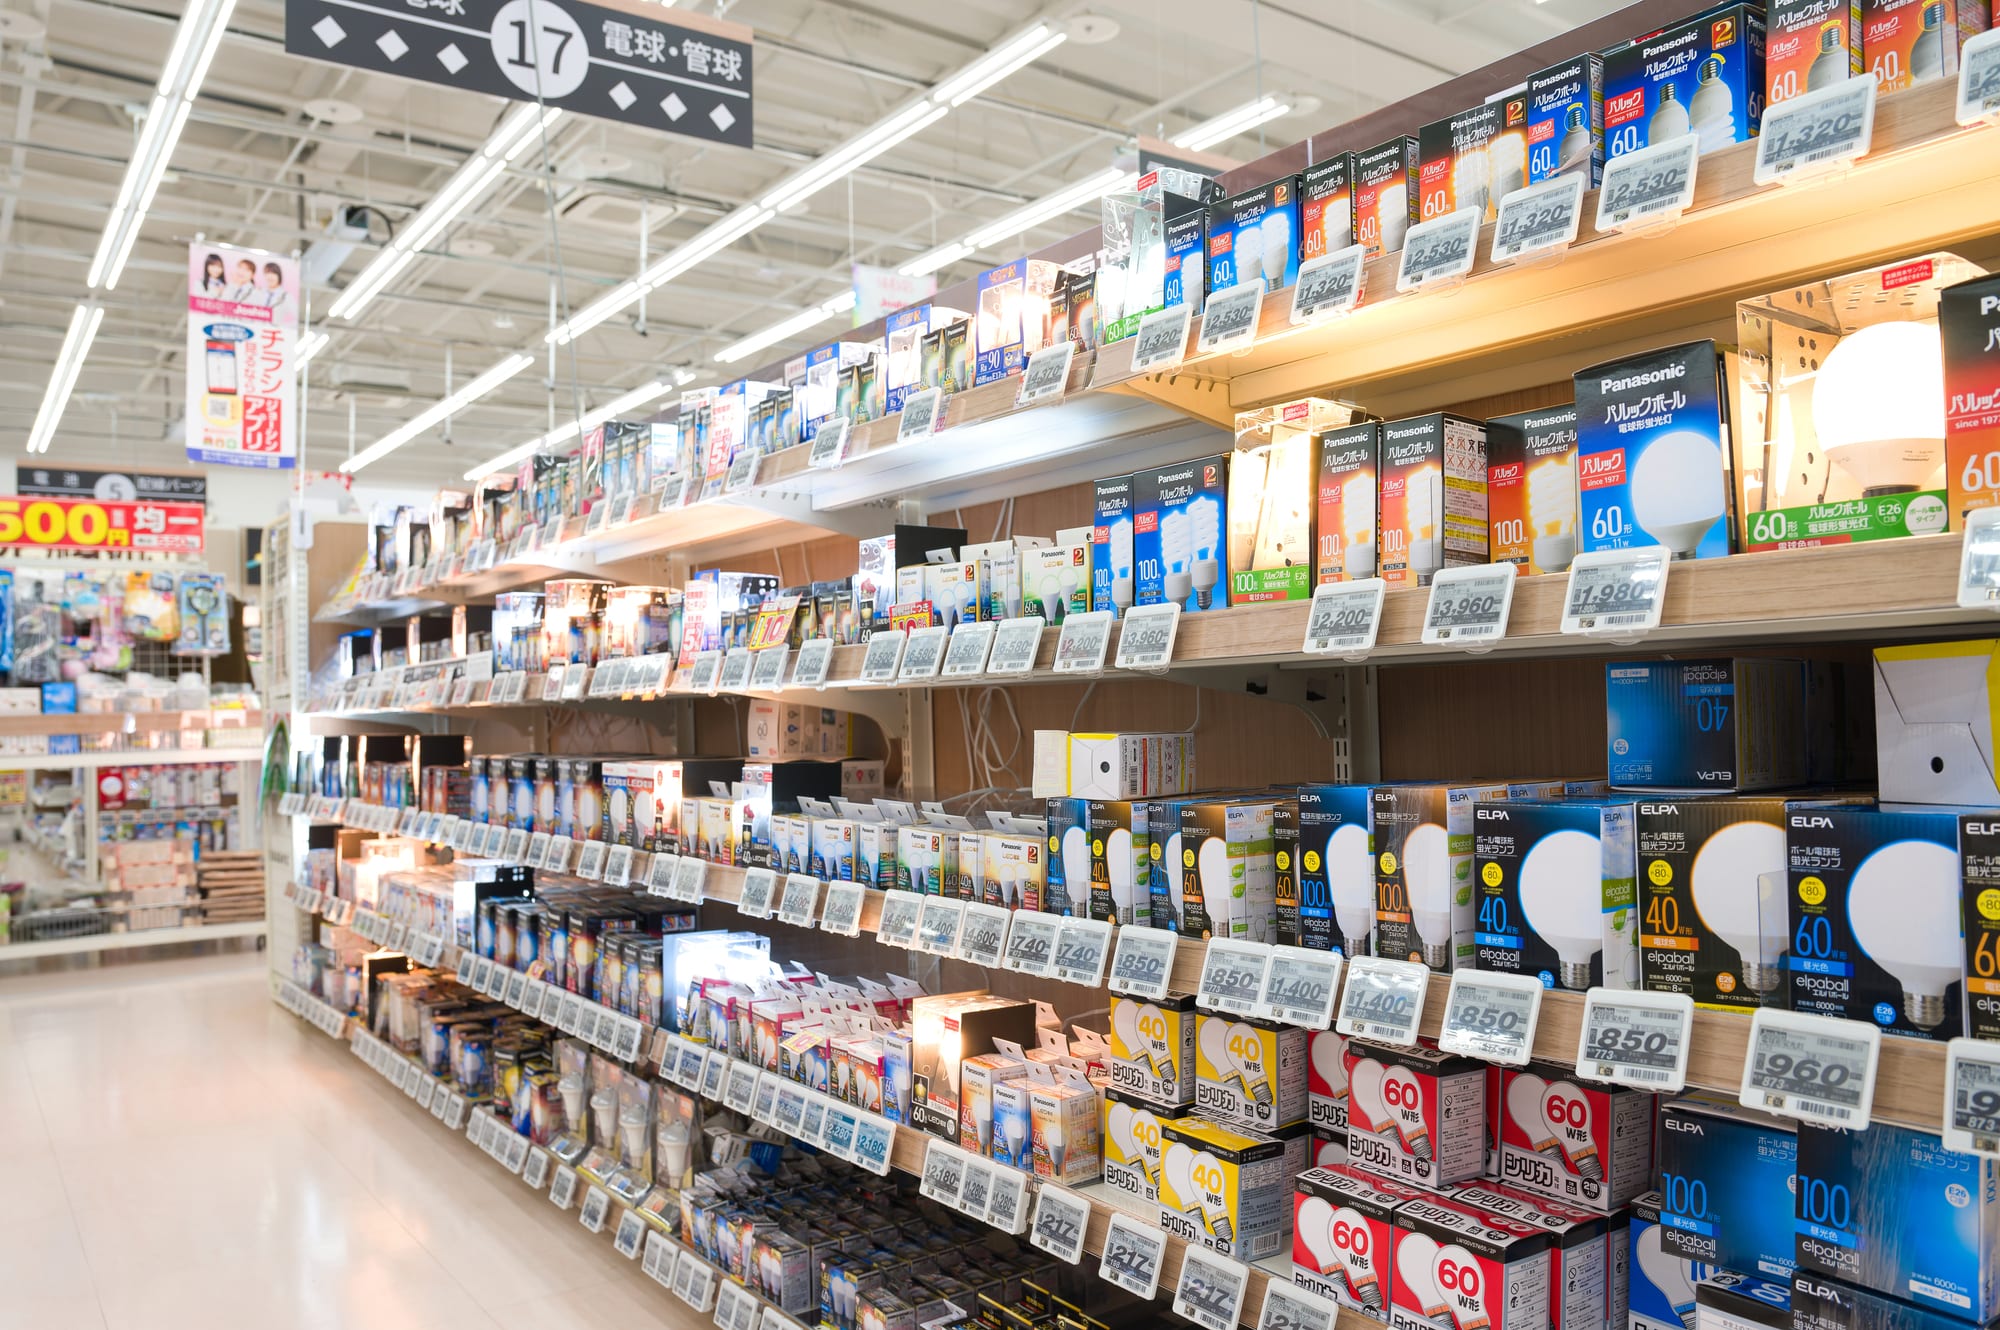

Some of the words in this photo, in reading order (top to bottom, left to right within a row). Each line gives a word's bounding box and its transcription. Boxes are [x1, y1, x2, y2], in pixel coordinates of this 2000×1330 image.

[1869, 16, 1898, 36] パルック
[508, 20, 573, 74] 17
[602, 19, 743, 81] 電球・管球
[1642, 30, 1698, 59] Panasonic
[1771, 37, 1799, 55] パルック
[1644, 48, 1698, 78] パルックボール
[1532, 63, 1581, 92] Panasonic
[1534, 81, 1580, 108] パルックボール
[1608, 91, 1641, 116] パルック
[1450, 109, 1496, 131] Panasonic
[1776, 113, 1850, 151] 1,320
[1359, 146, 1400, 168] Panasonic
[1306, 160, 1344, 182] Panasonic
[1362, 161, 1400, 183] パルックボール
[1422, 161, 1446, 177] パルック
[1614, 168, 1678, 200] 2,530
[1232, 190, 1267, 209] Panasonic
[1168, 218, 1199, 235] Panasonic
[1507, 203, 1564, 234] 1,320
[1413, 237, 1462, 265] 2,530
[1304, 273, 1348, 300] 1,320
[261, 329, 284, 394] チラシ
[1601, 363, 1686, 395] Panasonic
[1604, 390, 1686, 425] パルックボール
[245, 397, 266, 450] アプリ
[1524, 411, 1577, 430] Panasonic
[1618, 414, 1672, 434] 電球形蛍光灯
[1324, 431, 1369, 449] Panasonic
[1387, 423, 1435, 440] Panasonic
[1525, 429, 1577, 450] パルックボール
[1325, 449, 1368, 468] パルックボール
[1387, 440, 1434, 460] パルックボール
[1493, 465, 1518, 480] パルック
[1582, 452, 1622, 475] パルック
[1158, 469, 1194, 485] Panasonic
[1383, 479, 1404, 491] パルック
[1586, 477, 1603, 487] since
[1604, 475, 1619, 485] 1977
[1097, 484, 1128, 496] Panasonic
[1808, 501, 1868, 520] パルックボール
[1877, 503, 1902, 516] E26
[1908, 505, 1943, 516] ボール電球
[1915, 514, 1936, 523] タイプ
[134, 506, 199, 534] 均一
[1808, 517, 1869, 535] 電球形蛍光灯
[1041, 550, 1066, 559] Panasonic
[1581, 583, 1645, 605] 1,980
[1440, 596, 1494, 618] 3,960
[1320, 608, 1365, 630] 2,200
[1131, 629, 1163, 645] 3,960
[1683, 668, 1727, 684] elpaball
[1697, 771, 1731, 781] ELPA
[1300, 794, 1321, 803] ELPA
[1375, 793, 1398, 802] ELPA
[1450, 794, 1469, 803] ELPA
[1510, 789, 1528, 798] ELPA
[1091, 803, 1105, 811] ELPA
[1181, 810, 1196, 818] ELPA
[1274, 811, 1291, 819] ELPA
[1477, 810, 1510, 821] ELPA
[1640, 804, 1679, 815] ELPA
[1604, 813, 1622, 822] ELPA
[1791, 816, 1834, 829] ELPA
[1476, 836, 1515, 845] ボール電球形
[1640, 832, 1685, 841] ボール電球形
[1640, 840, 1686, 851] 蛍光ランプ
[1001, 842, 1022, 851] Panasonic
[1476, 844, 1515, 854] 蛍光ランプ
[1790, 846, 1841, 857] ボール電球形
[1790, 856, 1842, 868] 蛍光ランプ
[1015, 936, 1046, 953] 740
[1485, 935, 1505, 946] 昼光色
[1653, 937, 1677, 947] 電球色
[1062, 944, 1096, 962] 740
[1480, 948, 1520, 963] elpaball
[1647, 951, 1695, 964] elpaball
[1123, 954, 1160, 973] 850
[1803, 961, 1829, 972] 昼光色
[1212, 968, 1255, 987] 850
[1796, 974, 1849, 992] elpaball
[1276, 977, 1323, 1001] 1,400
[1356, 989, 1408, 1015] 1,400
[1876, 1006, 1893, 1016] E26
[1138, 1016, 1165, 1041] 40
[1461, 1008, 1519, 1030] 850
[1151, 1040, 1166, 1051] W形
[1229, 1034, 1260, 1061] 40
[1597, 1028, 1670, 1054] 850
[1593, 1048, 1616, 1060] 773
[964, 1065, 986, 1078] Panasonic
[1112, 1063, 1144, 1088] シリカ
[1243, 1060, 1261, 1073] W形
[1764, 1053, 1853, 1087] 960
[1762, 1077, 1786, 1090] 873
[995, 1088, 1016, 1100] Panasonic
[1033, 1096, 1056, 1108] Panasonic
[1198, 1084, 1236, 1111] シリカ
[1384, 1078, 1419, 1110] 60
[1400, 1108, 1420, 1124] W形
[1547, 1095, 1587, 1128] 60
[1665, 1119, 1704, 1136] ELPA
[1967, 1117, 1996, 1131] 873
[1133, 1121, 1159, 1147] 40
[1565, 1127, 1588, 1142] W形
[861, 1135, 883, 1154] 2,180
[1350, 1133, 1391, 1168] シリカ
[1504, 1152, 1553, 1188] シリカ
[1911, 1149, 1971, 1172] 蛍光ランプ
[930, 1165, 956, 1184] 2,180
[1106, 1164, 1139, 1192] シリカ
[1192, 1164, 1222, 1194] 40
[1302, 1168, 1359, 1190] シリカ
[1205, 1192, 1222, 1206] W形
[1462, 1187, 1519, 1213] シリカ
[1948, 1187, 1967, 1198] E26
[1404, 1202, 1464, 1226] シリカ
[1044, 1215, 1075, 1237] 217
[1672, 1217, 1698, 1231] 昼光色
[1810, 1225, 1838, 1242] 昼光色
[1333, 1220, 1368, 1256] 60
[1666, 1229, 1716, 1252] elpaball
[1115, 1244, 1150, 1267] 217
[1349, 1253, 1369, 1269] W形
[1802, 1239, 1859, 1266] elpaball
[1438, 1258, 1480, 1297] 60
[1188, 1278, 1229, 1305] 217
[1795, 1279, 1842, 1304] ELPA
[1457, 1295, 1480, 1312] W形
